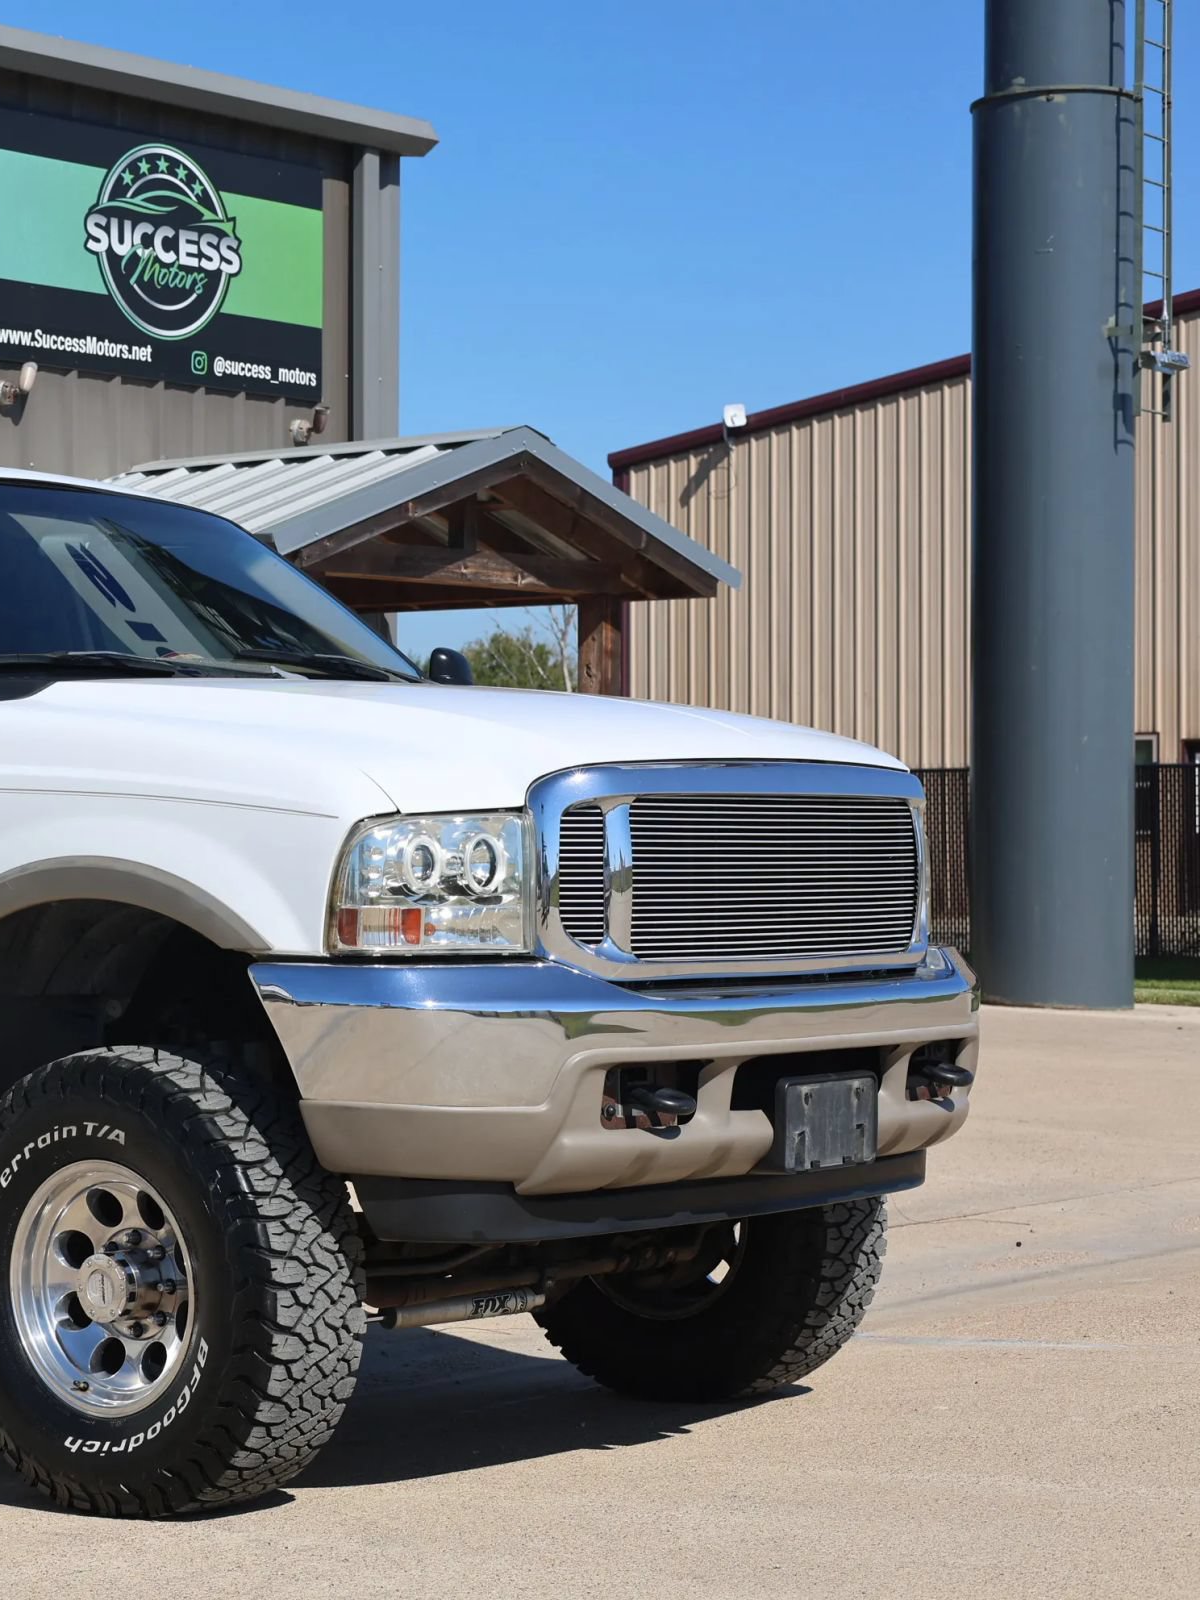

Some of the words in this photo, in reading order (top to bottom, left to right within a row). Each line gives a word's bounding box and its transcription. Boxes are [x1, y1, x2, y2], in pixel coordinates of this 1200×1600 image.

[86, 213, 241, 274] SUCCESS
[121, 243, 208, 294] Motors
[213, 356, 317, 387] @success_motors
[83, 1121, 126, 1146] T/A
[471, 1293, 512, 1317] FOX
[64, 1336, 208, 1457] BFGoodrich
